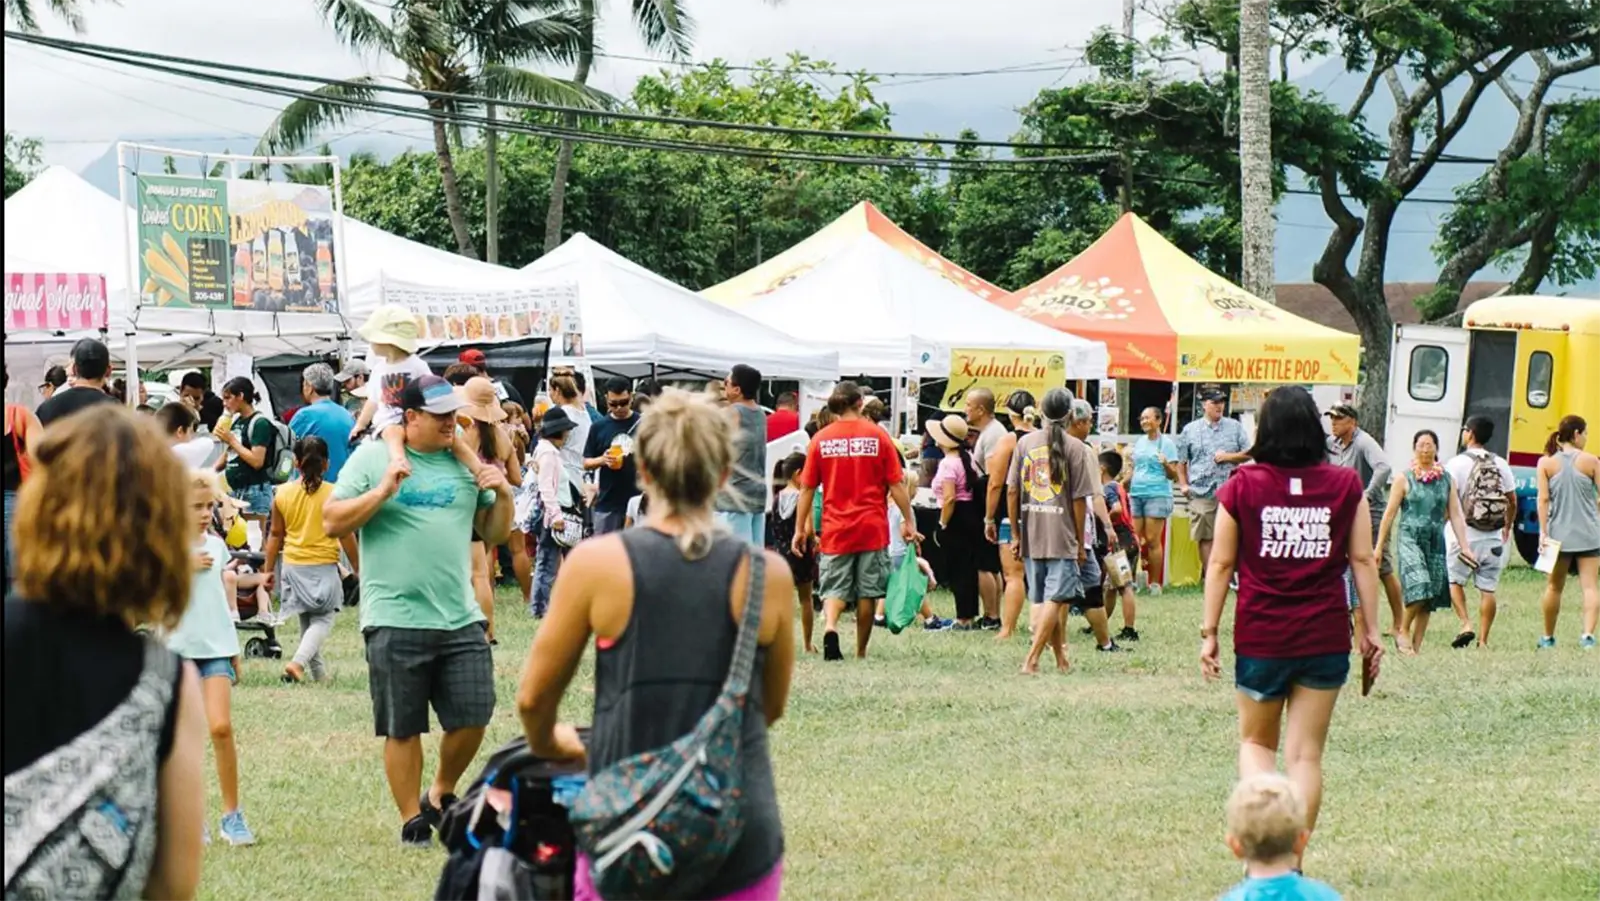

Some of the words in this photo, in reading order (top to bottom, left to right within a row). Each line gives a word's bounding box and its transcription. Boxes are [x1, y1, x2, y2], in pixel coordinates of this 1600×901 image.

[171, 203, 225, 235] CORN
[1215, 358, 1244, 379] ONO
[1247, 358, 1292, 379] KETTLE
[1294, 360, 1320, 380] POP
[1261, 506, 1331, 523] GROWING
[1260, 540, 1332, 558] FUTURE!
